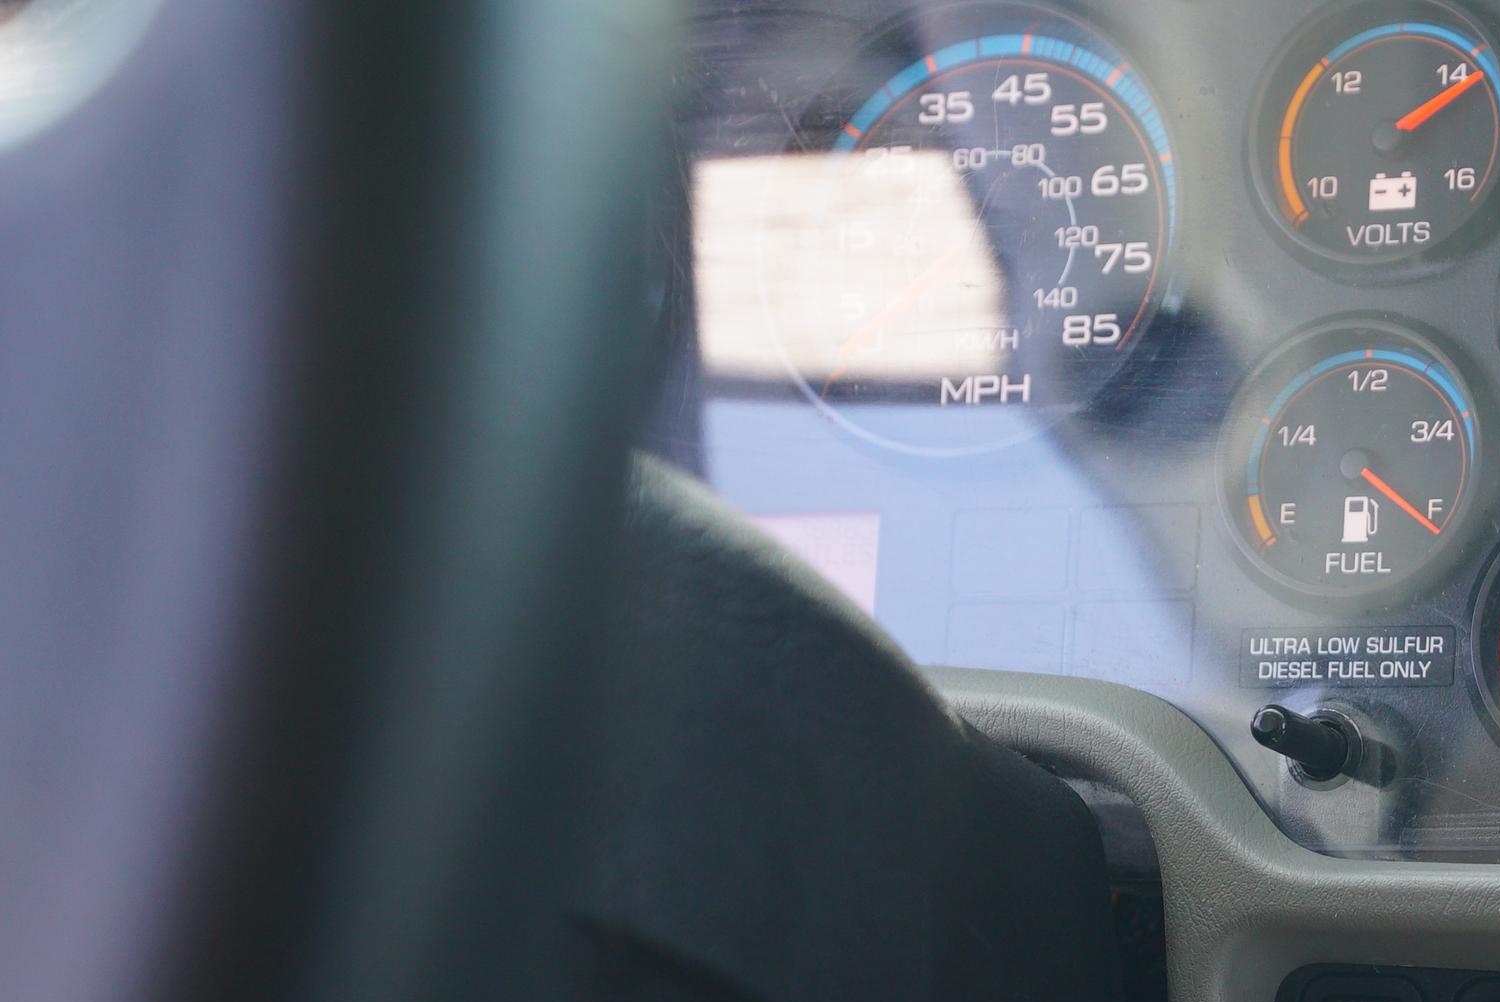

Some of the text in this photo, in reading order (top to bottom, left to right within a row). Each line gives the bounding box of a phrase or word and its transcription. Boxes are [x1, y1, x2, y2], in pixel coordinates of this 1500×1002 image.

[1331, 70, 1363, 94] 12
[1436, 62, 1470, 85] 14
[992, 73, 1051, 104] 45
[919, 92, 973, 124] 35
[1050, 103, 1108, 136] 55
[952, 149, 987, 170] 60
[1011, 144, 1046, 166] 80
[1038, 177, 1082, 198] 100
[1091, 164, 1148, 196] 65
[1308, 175, 1338, 199] 10
[1443, 168, 1476, 190] 16
[1055, 226, 1099, 247] 120
[1346, 221, 1431, 247] VOLTS
[1095, 242, 1152, 273] 75
[1033, 287, 1077, 308] 140
[1062, 314, 1122, 345] 85
[940, 375, 1031, 404] MPH
[1348, 368, 1388, 392] 1/2
[1278, 425, 1316, 447] 1/4
[1410, 420, 1454, 443] 3/4
[1280, 503, 1295, 524] E
[1427, 499, 1442, 520] F
[1325, 552, 1391, 574] FUEL
[1250, 635, 1444, 656] ULTRA LOW SULFUR
[1258, 660, 1431, 680] DIESEL FUEL ONLY
